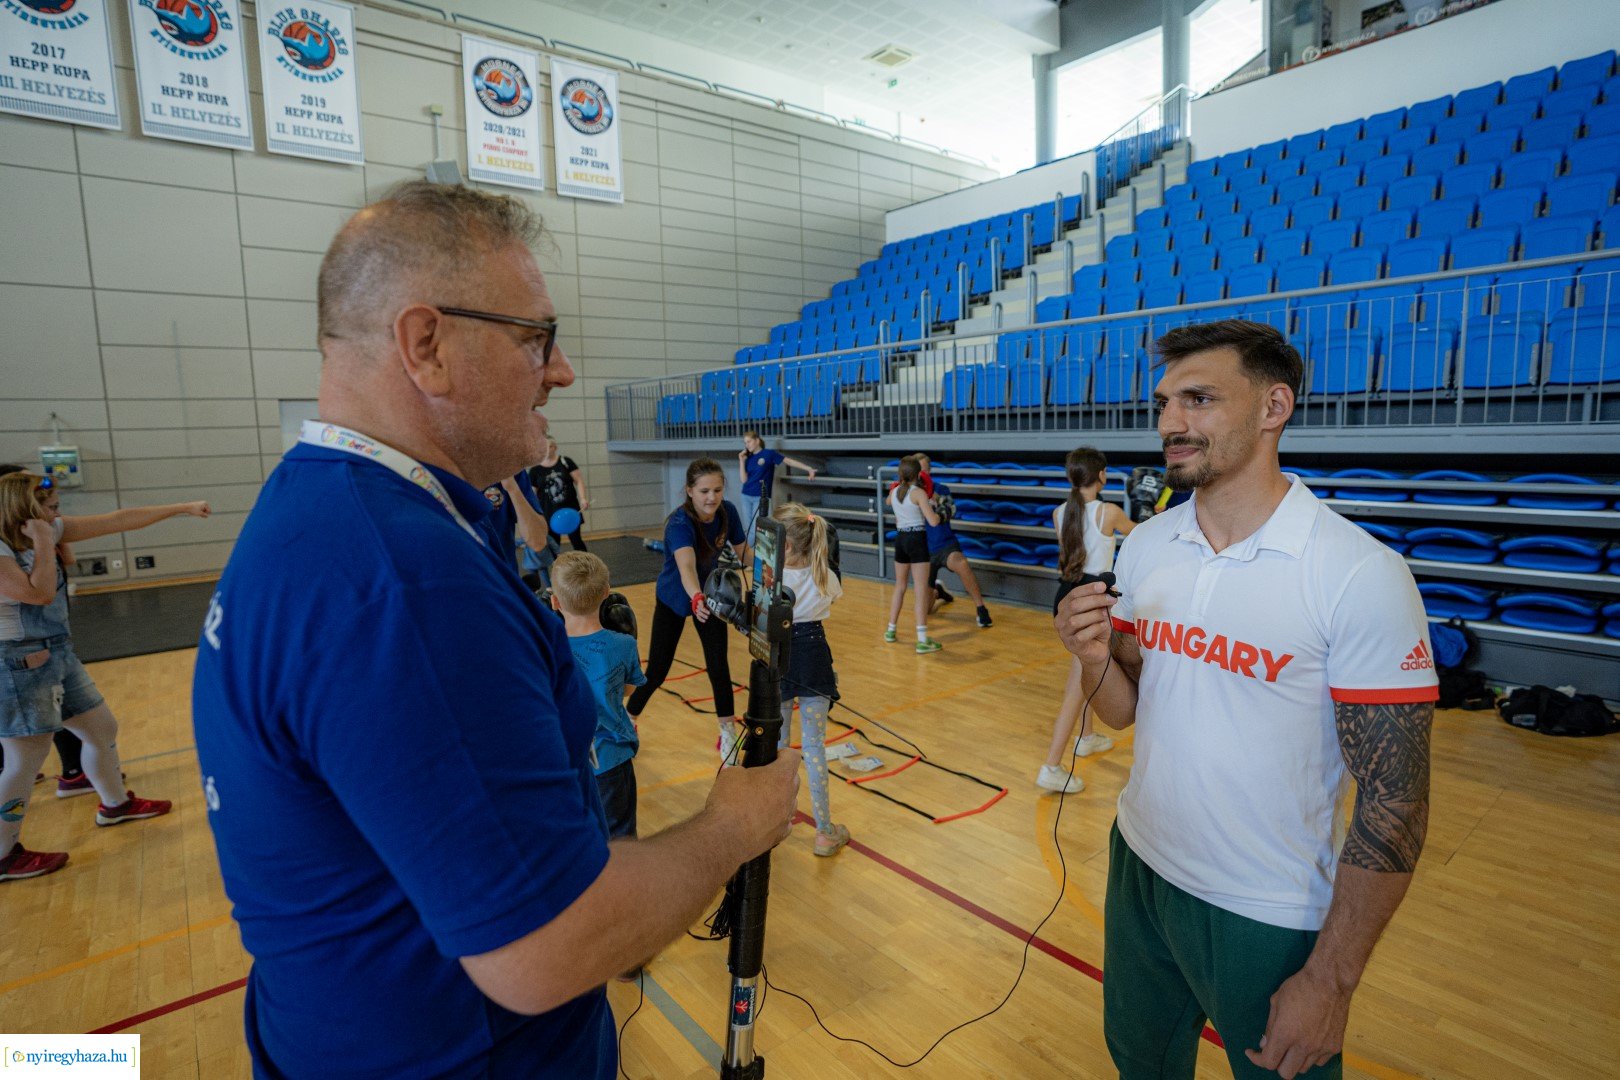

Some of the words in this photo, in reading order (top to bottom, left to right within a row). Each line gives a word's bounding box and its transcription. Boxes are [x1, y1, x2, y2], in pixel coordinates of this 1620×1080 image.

[0, 0, 90, 30] YÍREGYHÁZA
[266, 7, 297, 38] BLUE
[300, 8, 349, 56] SHARKS
[31, 41, 66, 60] 2017
[9, 55, 49, 73] HEPP
[53, 64, 91, 81] KUPA
[21, 77, 106, 106] HELYEZÉS
[179, 72, 209, 88] 2018
[161, 85, 194, 100] HEPP
[197, 91, 229, 107] KUPA
[301, 94, 327, 109] 2019
[151, 102, 167, 116] II.
[170, 105, 242, 129] HELYEZÉS
[285, 106, 315, 121] HEPP
[316, 111, 344, 125] KUPA
[275, 121, 289, 134] II.
[292, 124, 355, 145] HELYEZÉS
[569, 156, 589, 167] HEPP
[1400, 657, 1434, 671] adida
